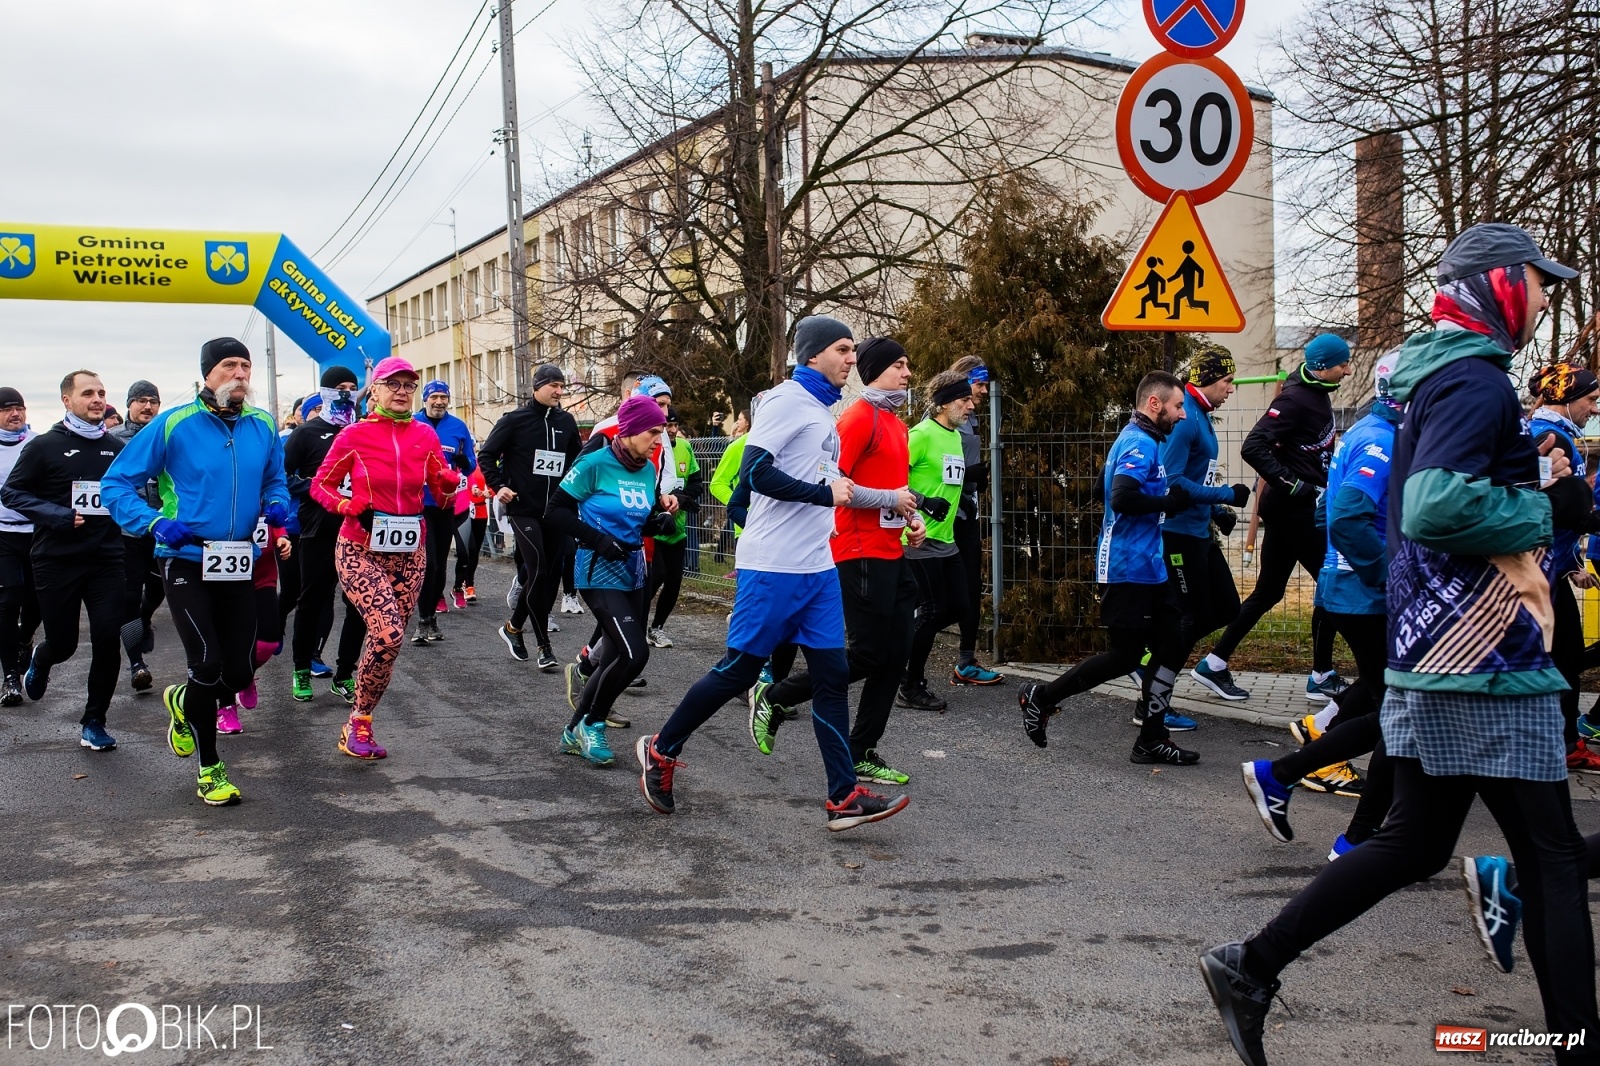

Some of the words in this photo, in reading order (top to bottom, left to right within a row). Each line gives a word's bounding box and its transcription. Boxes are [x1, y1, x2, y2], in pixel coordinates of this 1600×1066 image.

[1139, 88, 1232, 166] 30
[78, 235, 165, 250] Gmina
[55, 250, 188, 269] Pietrowice
[73, 269, 172, 286] Wielkie
[282, 260, 327, 305] Gmina
[325, 300, 365, 338] ludzi
[268, 277, 348, 351] aktywnych
[535, 458, 562, 473] 241
[75, 493, 102, 509] 40
[375, 529, 418, 546] 109
[206, 555, 250, 574] 239
[1395, 599, 1442, 659] 42,195
[1435, 576, 1466, 604] km
